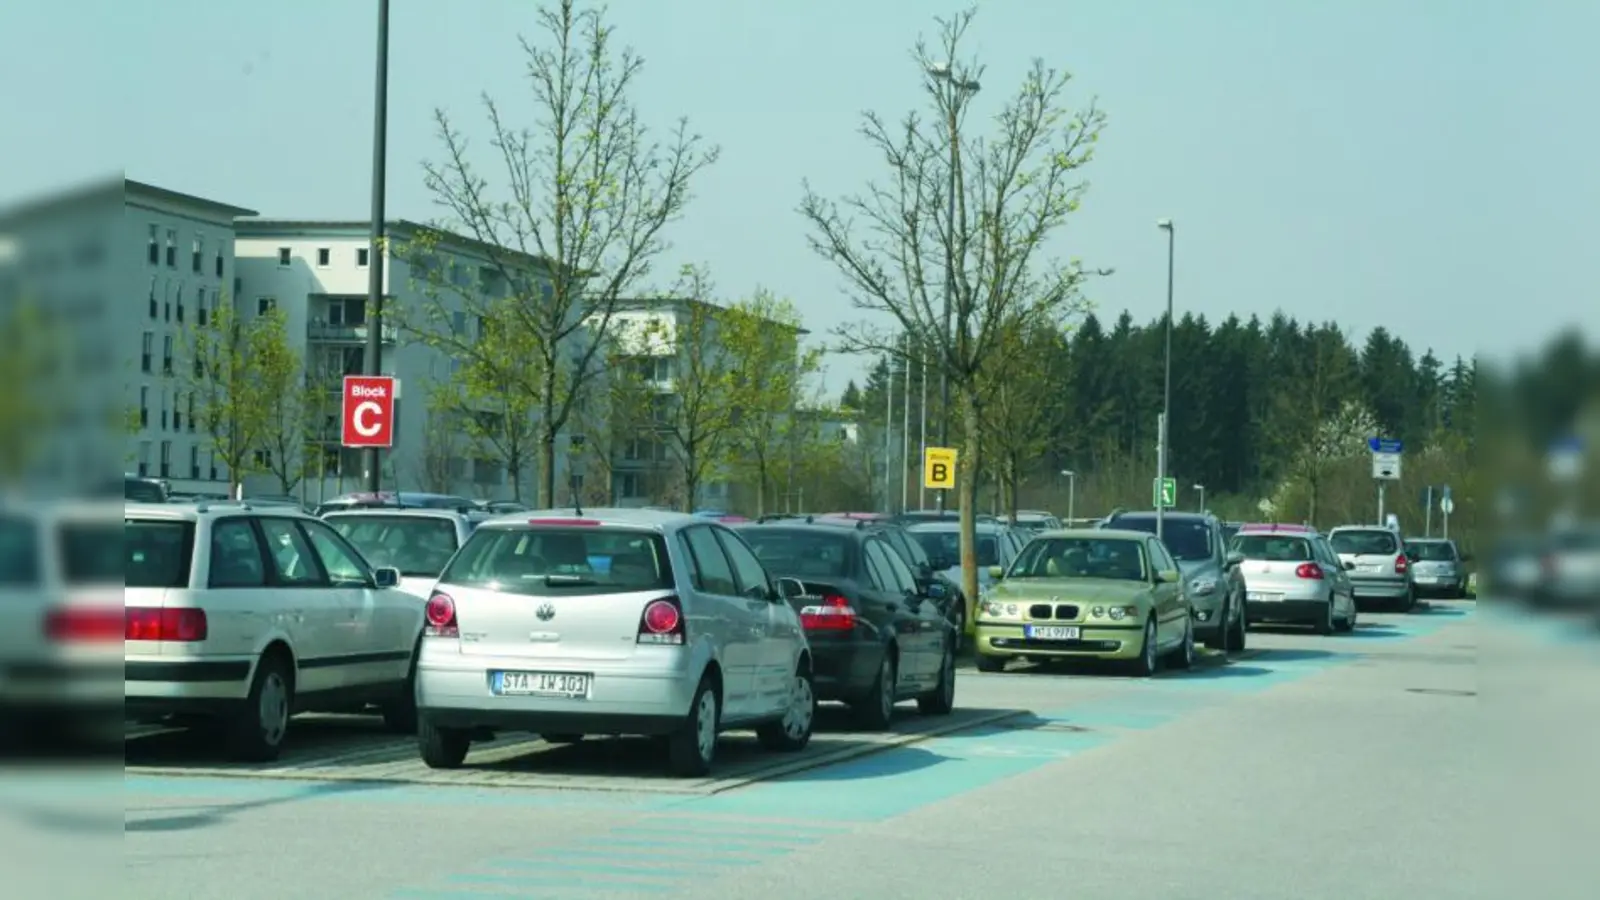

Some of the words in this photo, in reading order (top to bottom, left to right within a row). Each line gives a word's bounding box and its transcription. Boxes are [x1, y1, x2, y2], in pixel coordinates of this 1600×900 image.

[352, 385, 386, 397] Block
[353, 401, 383, 437] C
[932, 463, 948, 482] B
[503, 673, 529, 689] STA
